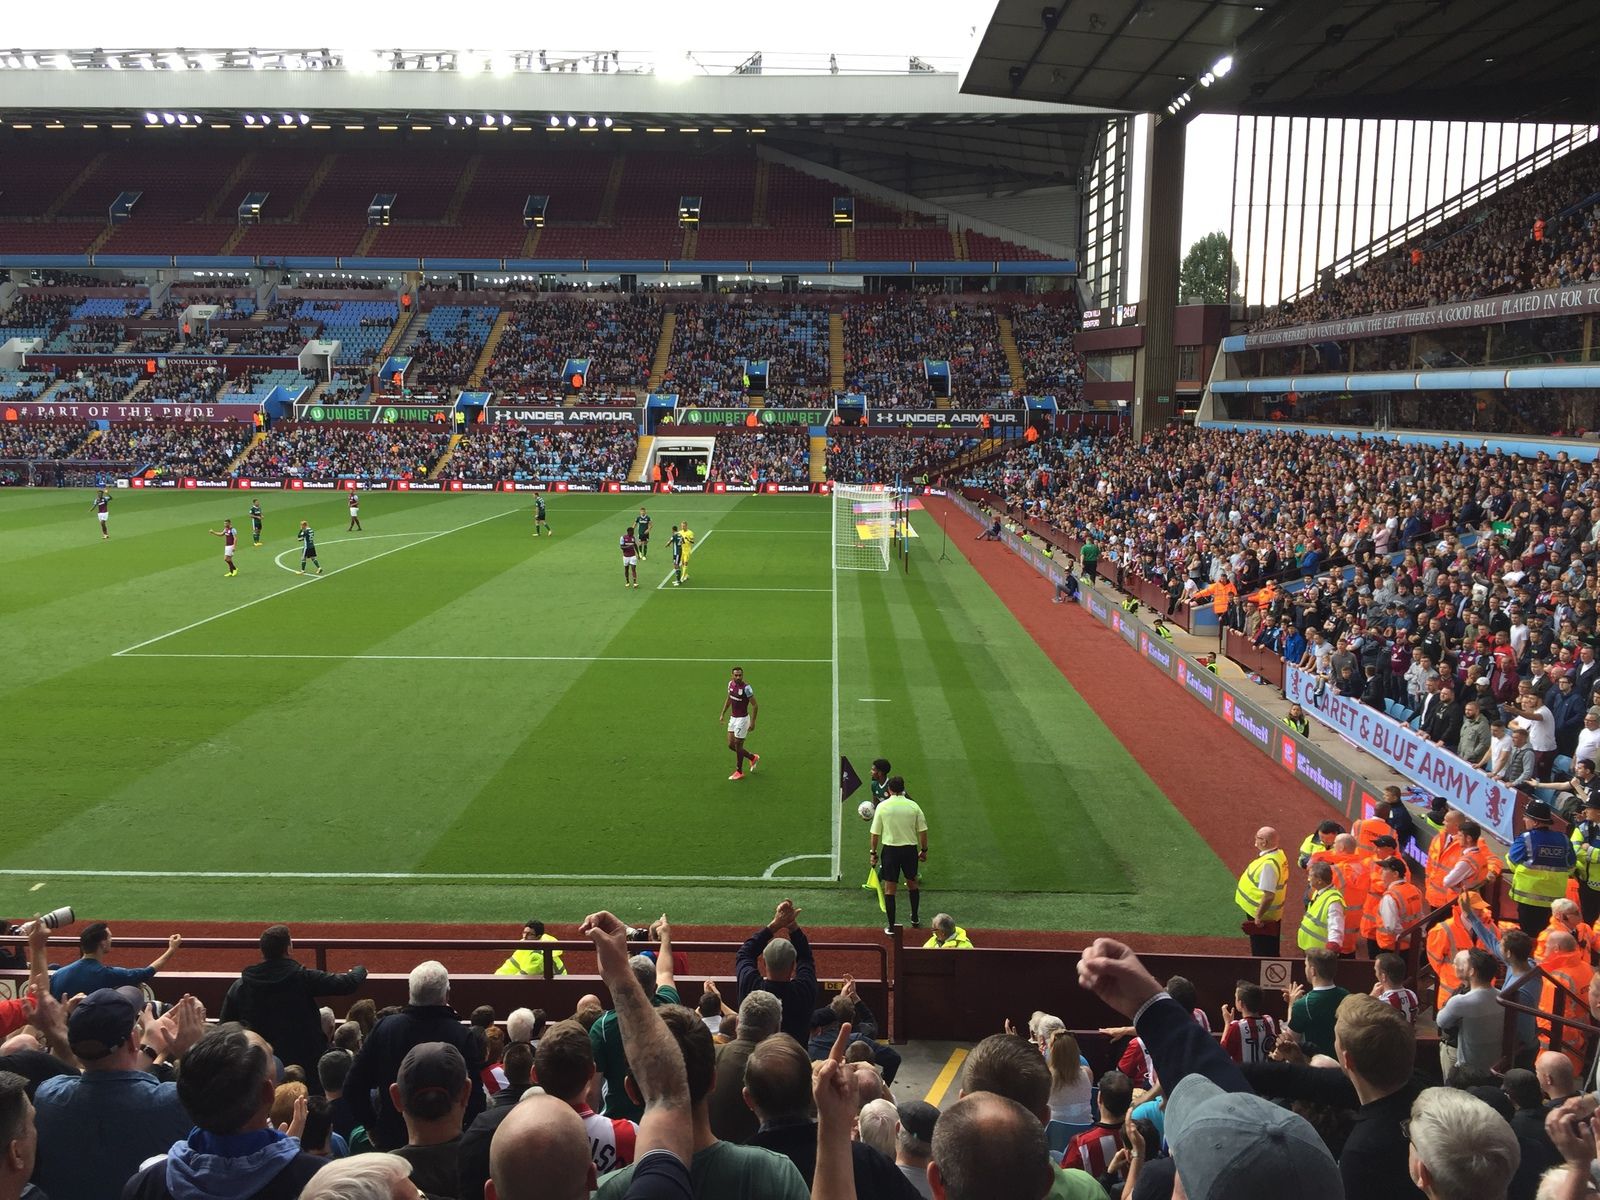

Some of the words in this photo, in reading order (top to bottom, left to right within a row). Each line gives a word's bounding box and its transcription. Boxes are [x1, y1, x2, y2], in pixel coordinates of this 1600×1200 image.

[1308, 327, 1317, 338] TO
[1317, 324, 1346, 338] VENTURE
[1346, 321, 1365, 334] DOWN
[1367, 319, 1381, 332] THE
[1437, 309, 1444, 323] A
[1446, 306, 1472, 322] GOOD
[1473, 302, 1497, 319] BALL
[1501, 295, 1540, 315] PLAYED
[1543, 293, 1557, 310] IN
[1560, 290, 1582, 308] FOR
[37, 406, 79, 417] PART
[88, 406, 109, 417] OF
[119, 406, 153, 417] THE
[162, 406, 215, 418] PRDE
[326, 408, 371, 420] UNIBET
[400, 409, 444, 420] UNIB
[514, 411, 564, 421] UNDER
[704, 412, 748, 423] UNIBET
[778, 412, 822, 423] UNIBET
[896, 413, 946, 423] UNDER
[1234, 706, 1269, 745] Einhell
[1360, 715, 1370, 741] &
[1372, 722, 1418, 770] BLUE
[1418, 751, 1479, 805] ARMY
[1297, 752, 1343, 802] Einhell
[1540, 847, 1564, 856] POLICE
